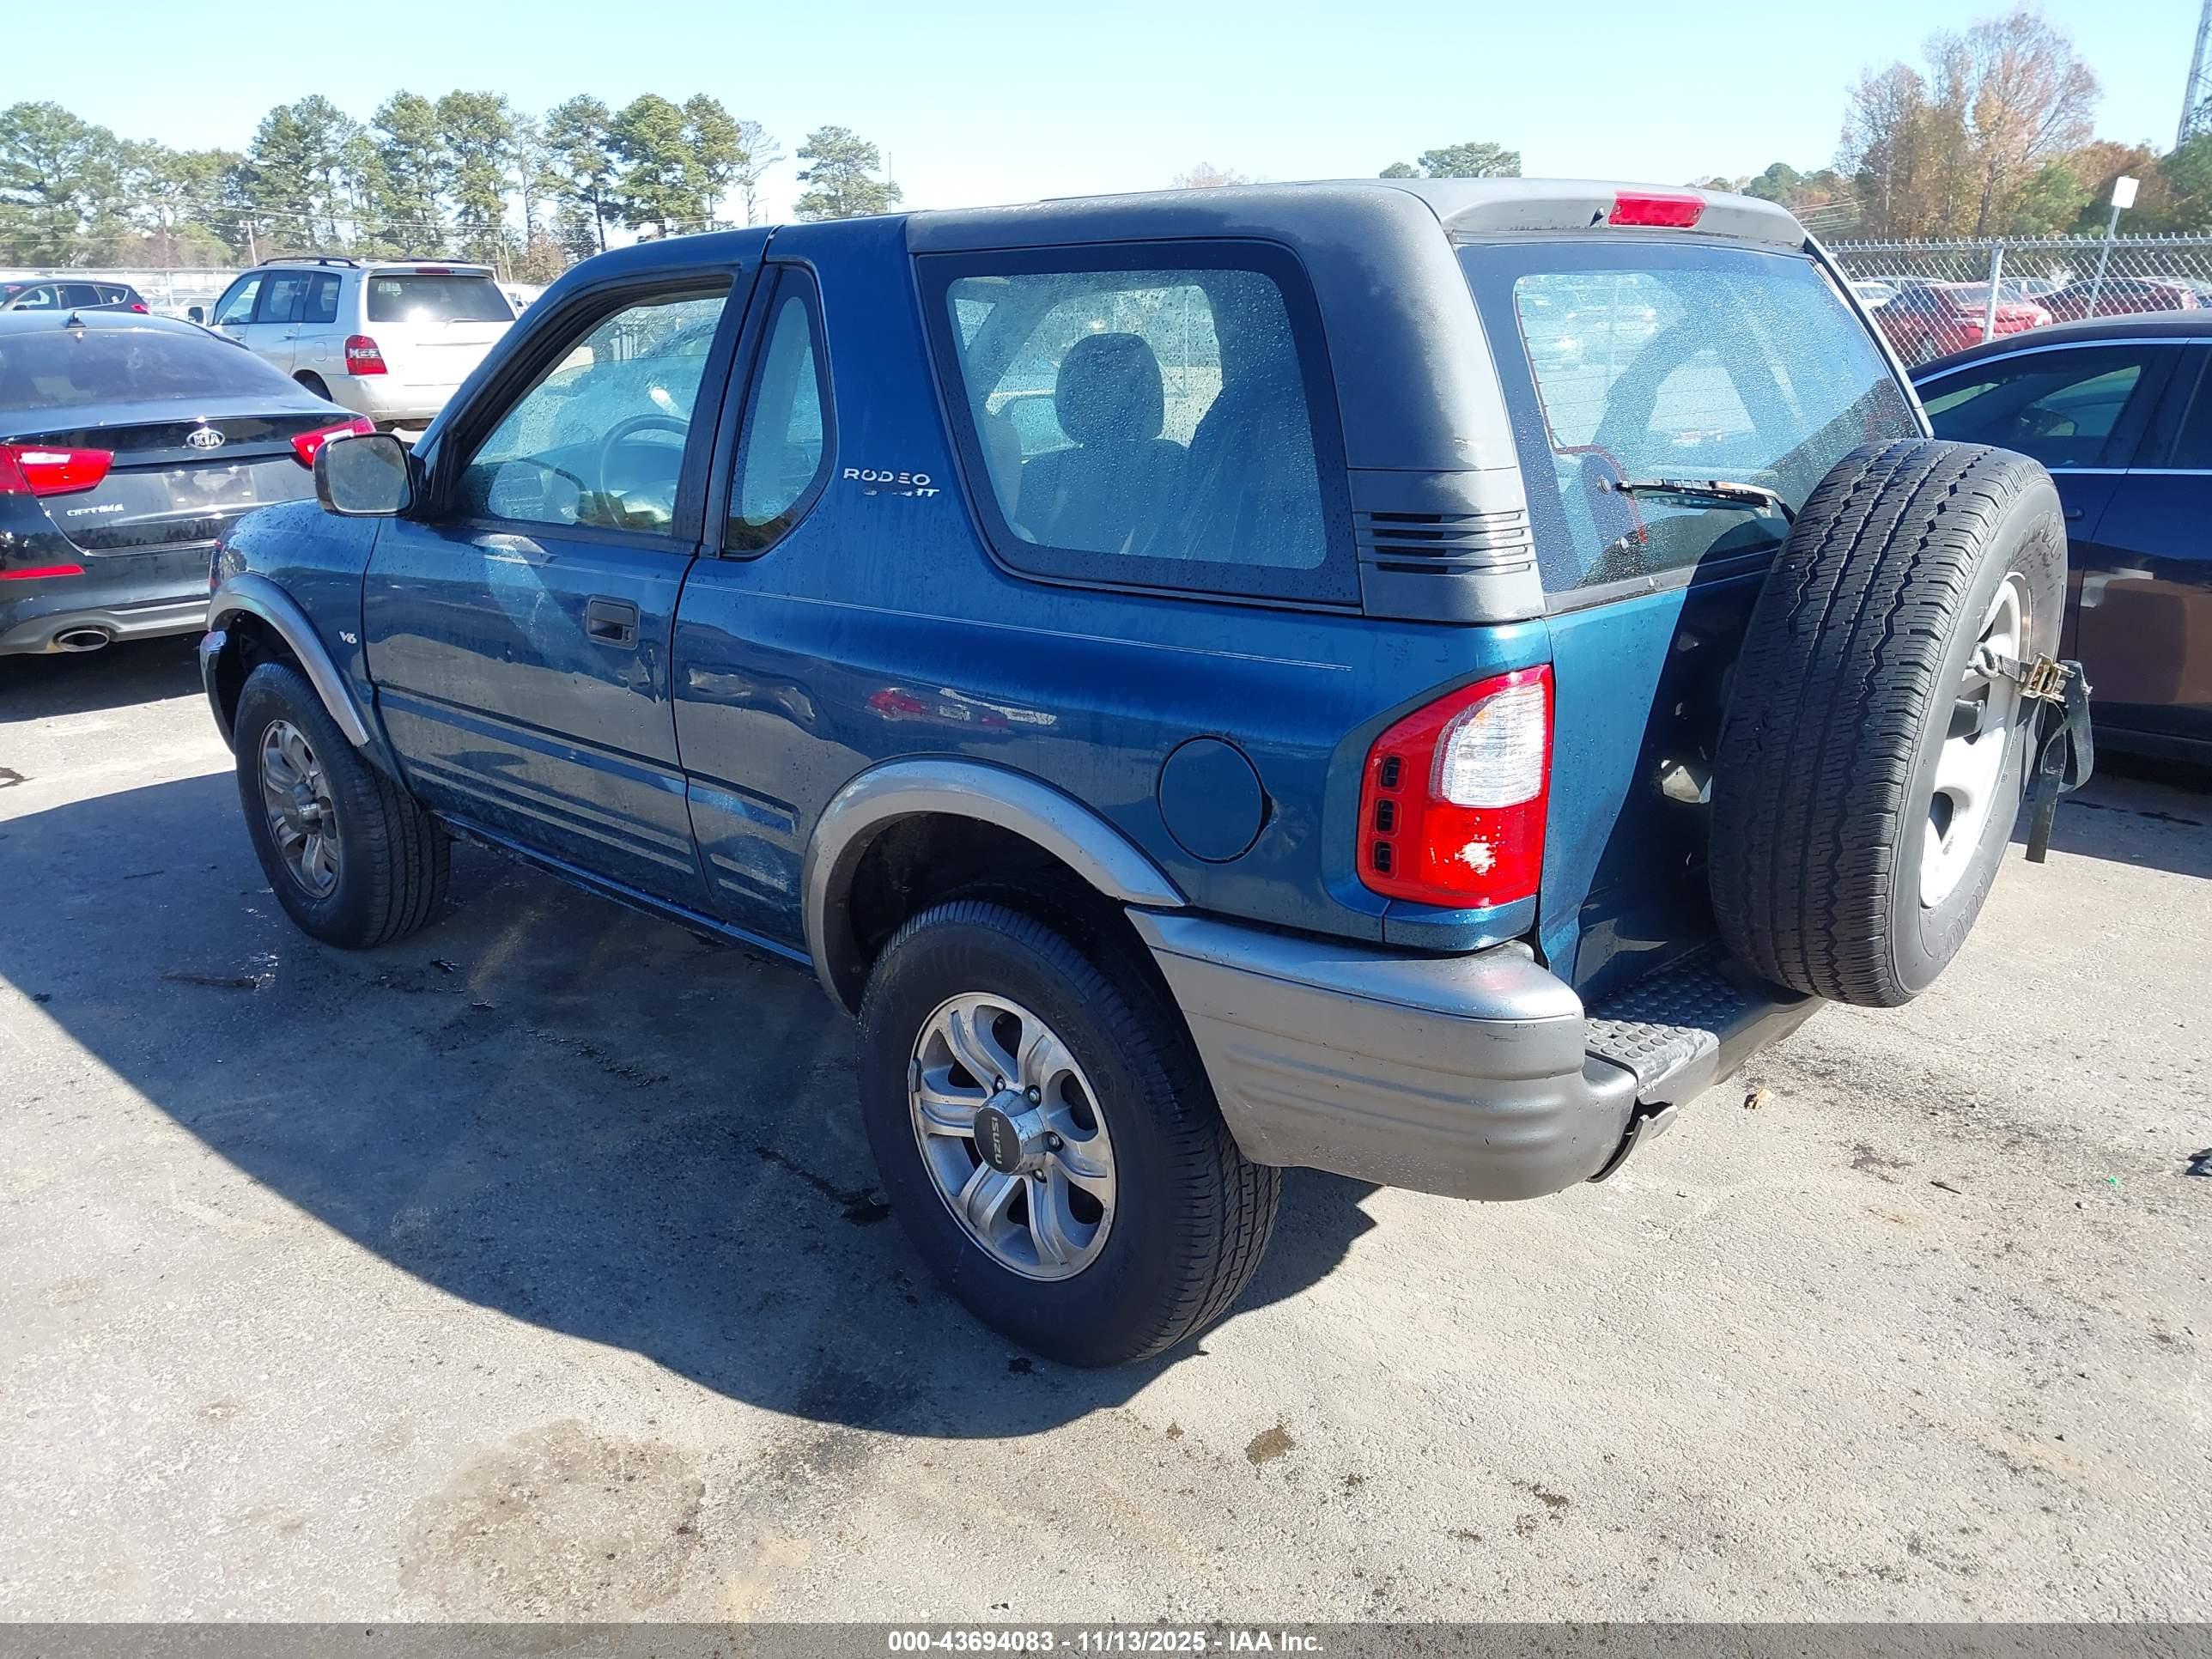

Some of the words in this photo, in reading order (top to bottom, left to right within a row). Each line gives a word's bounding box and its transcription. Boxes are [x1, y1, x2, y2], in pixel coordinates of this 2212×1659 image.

[843, 468, 931, 486] RODEO
[339, 631, 357, 644] V6
[991, 1116, 1003, 1165] ISUZU
